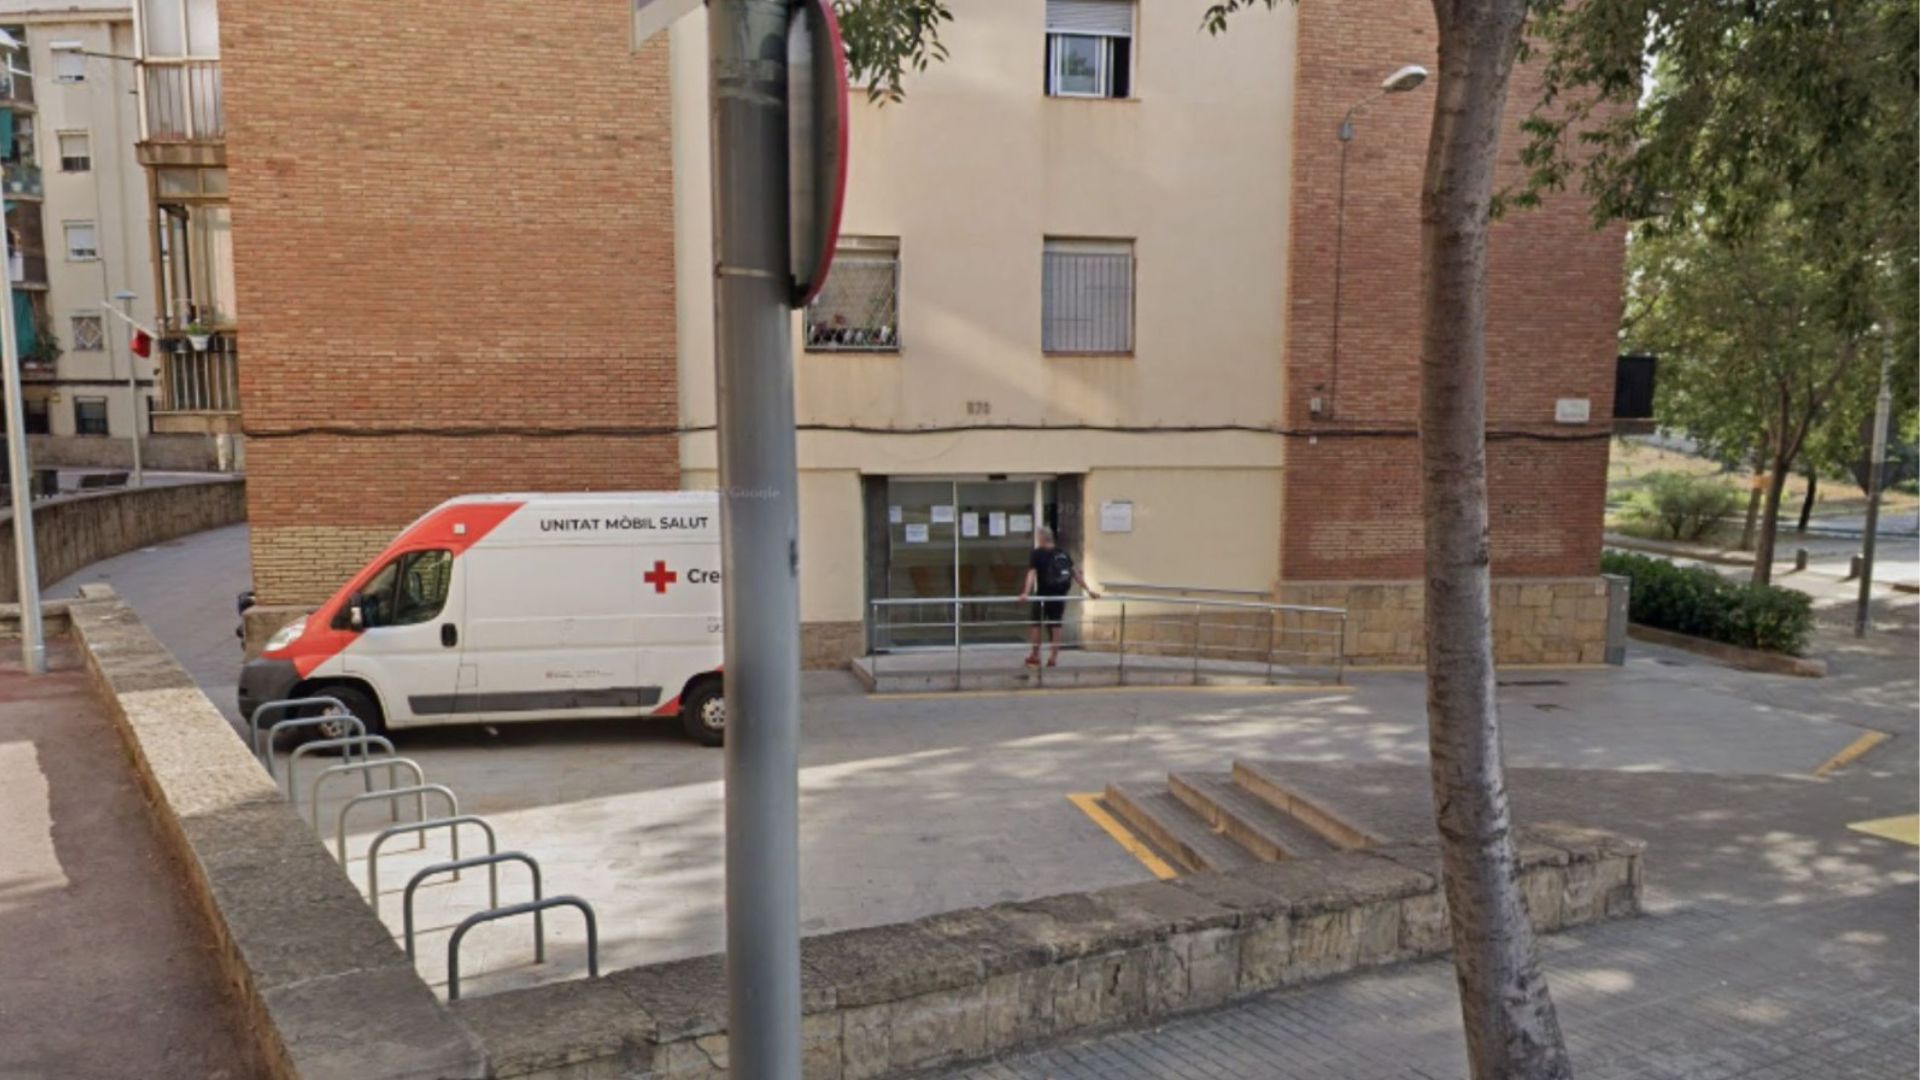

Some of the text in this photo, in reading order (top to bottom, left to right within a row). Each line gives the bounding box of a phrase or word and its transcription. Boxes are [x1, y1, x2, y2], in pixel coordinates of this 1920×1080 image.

[540, 515, 708, 531] UNITAT MÒBIL SALUT
[687, 568, 720, 583] Cre
